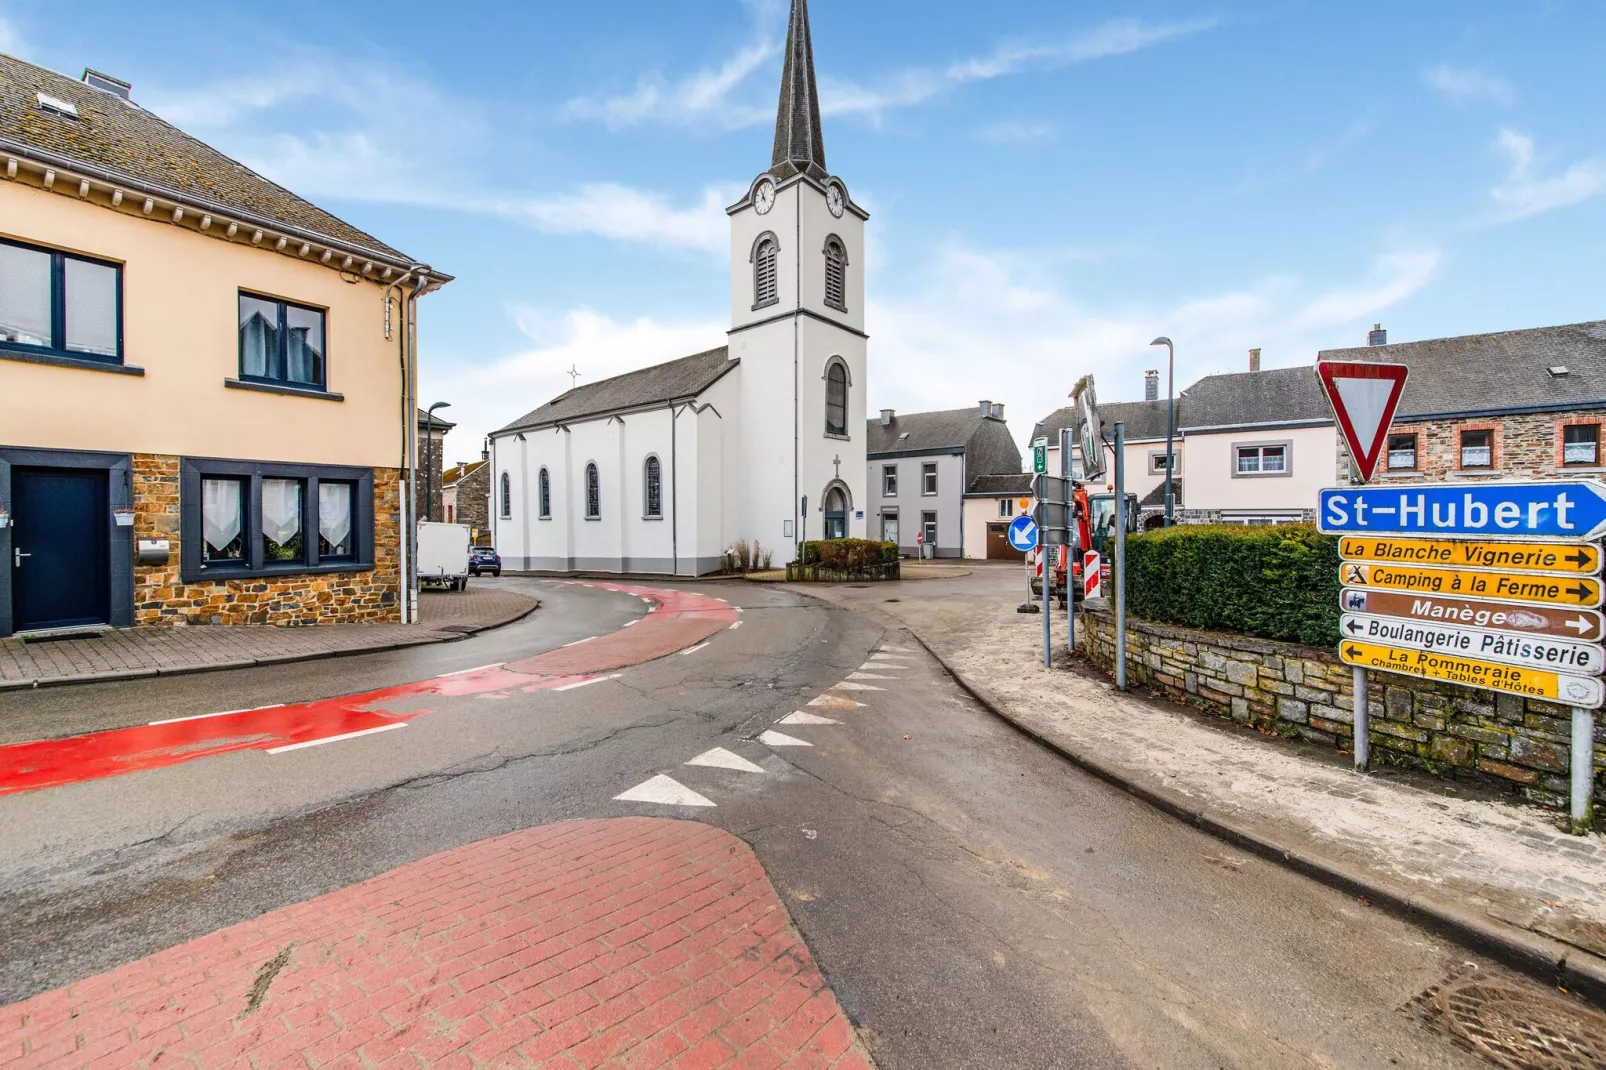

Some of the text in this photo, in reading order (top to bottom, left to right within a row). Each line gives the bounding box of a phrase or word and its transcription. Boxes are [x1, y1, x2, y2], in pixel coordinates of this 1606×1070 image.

[1327, 492, 1574, 529] St-Hubert
[1344, 542, 1557, 566] La Blanche Vignerie
[1373, 569, 1559, 598] Camping à la Ferme
[1411, 600, 1507, 625] Manège
[1369, 621, 1590, 667] Boulangerie Pâtisserie
[1371, 658, 1427, 676] Chambres
[1446, 671, 1486, 685] Tables
[1492, 678, 1544, 695] d'Hôtes
[1389, 649, 1521, 681] La Pommeraie
